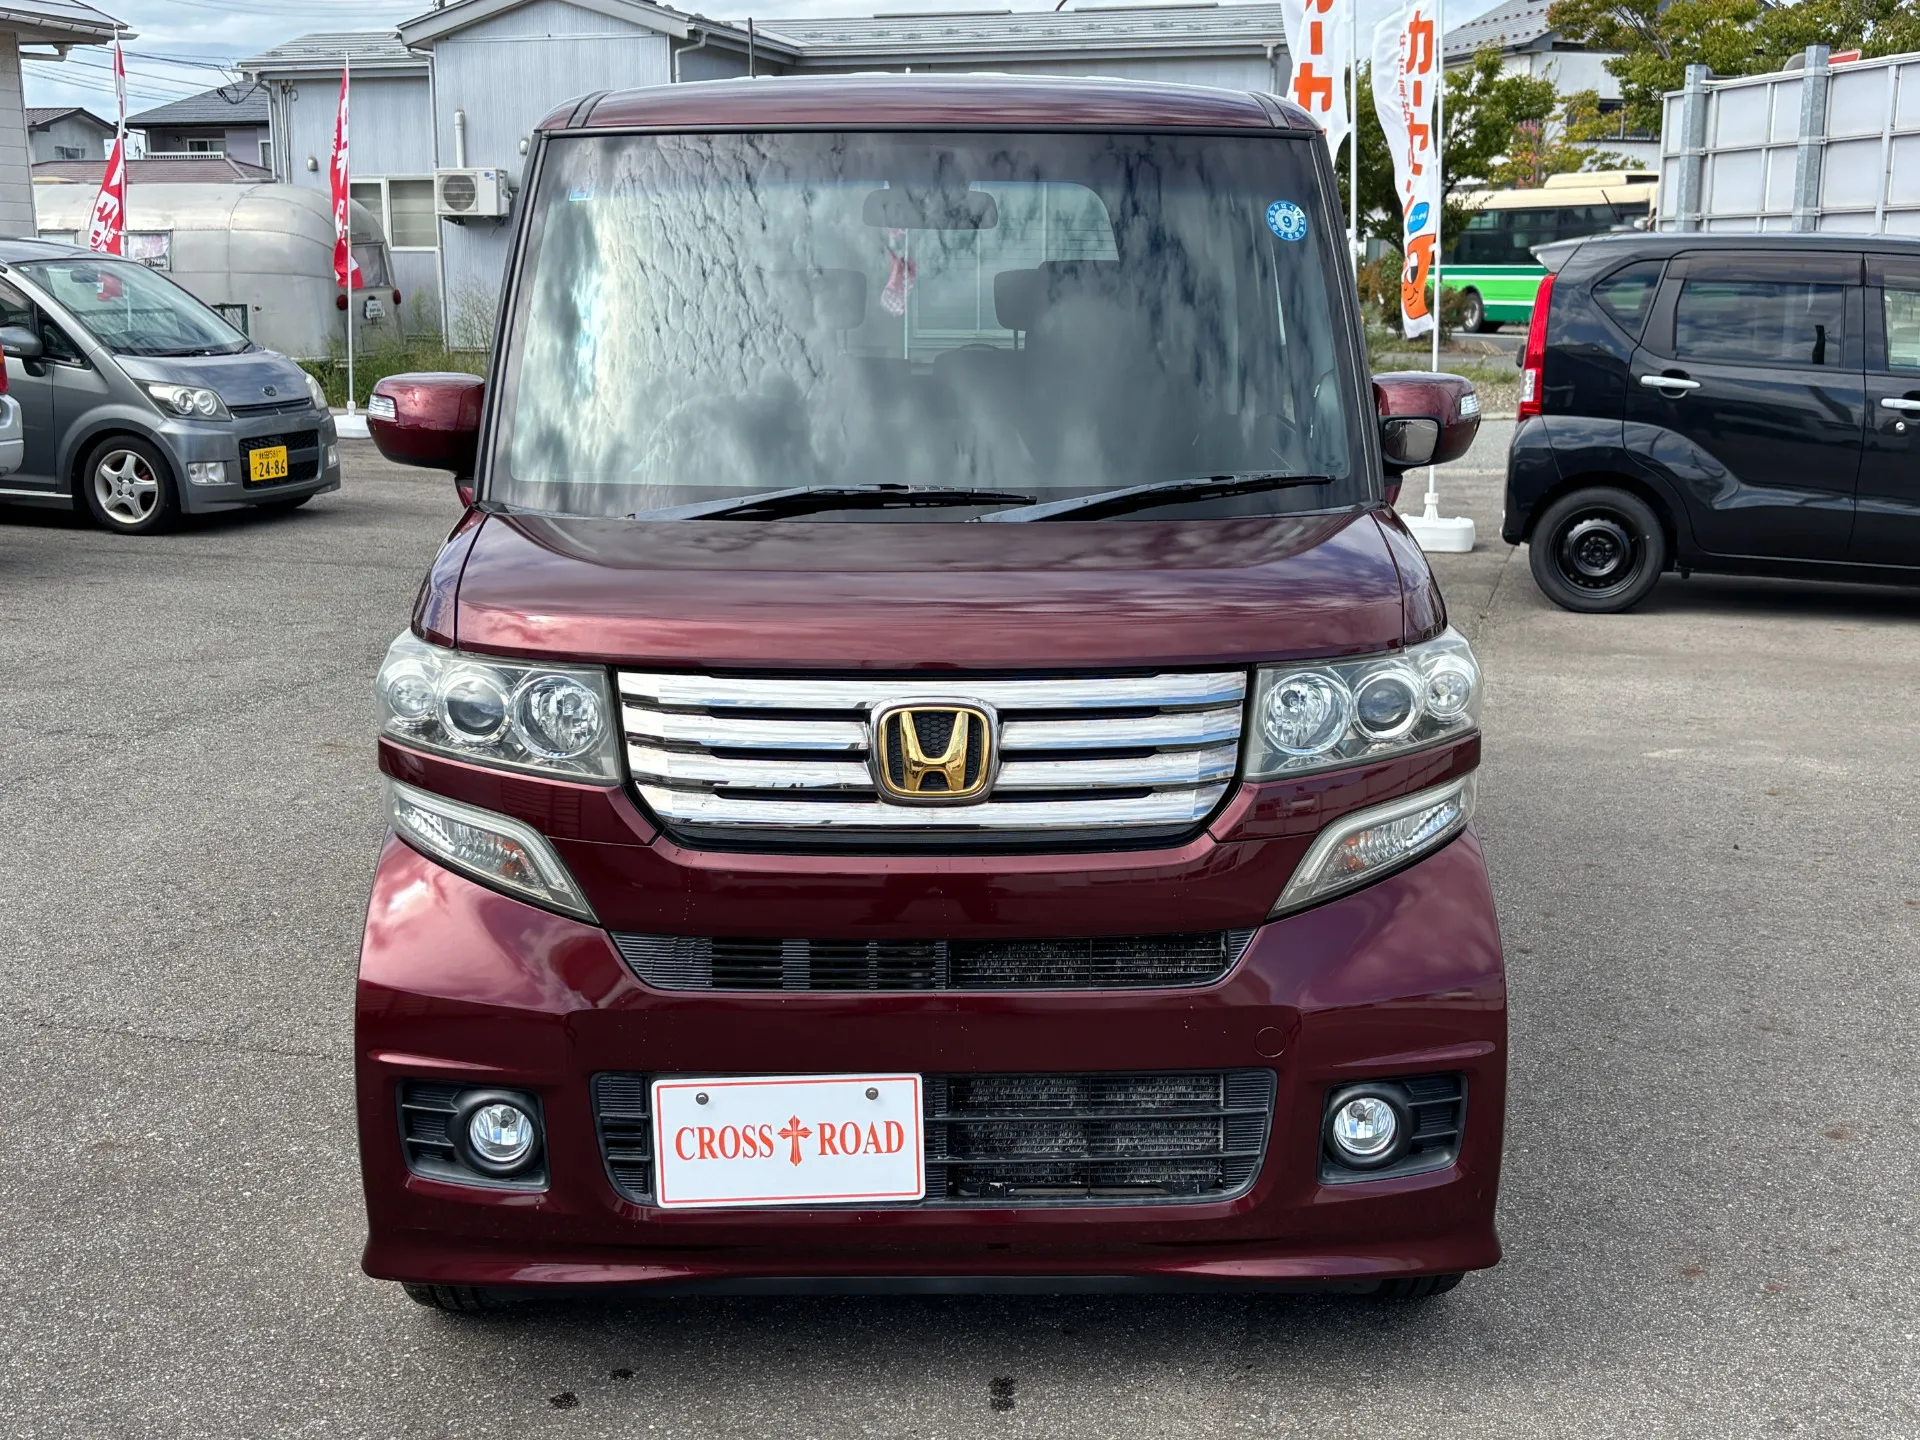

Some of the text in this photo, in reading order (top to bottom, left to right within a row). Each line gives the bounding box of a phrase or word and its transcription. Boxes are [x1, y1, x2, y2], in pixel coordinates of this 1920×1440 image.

[1282, 216, 1292, 228] 9
[259, 459, 286, 477] 24-86
[675, 1120, 905, 1161] CROSS ROAD
